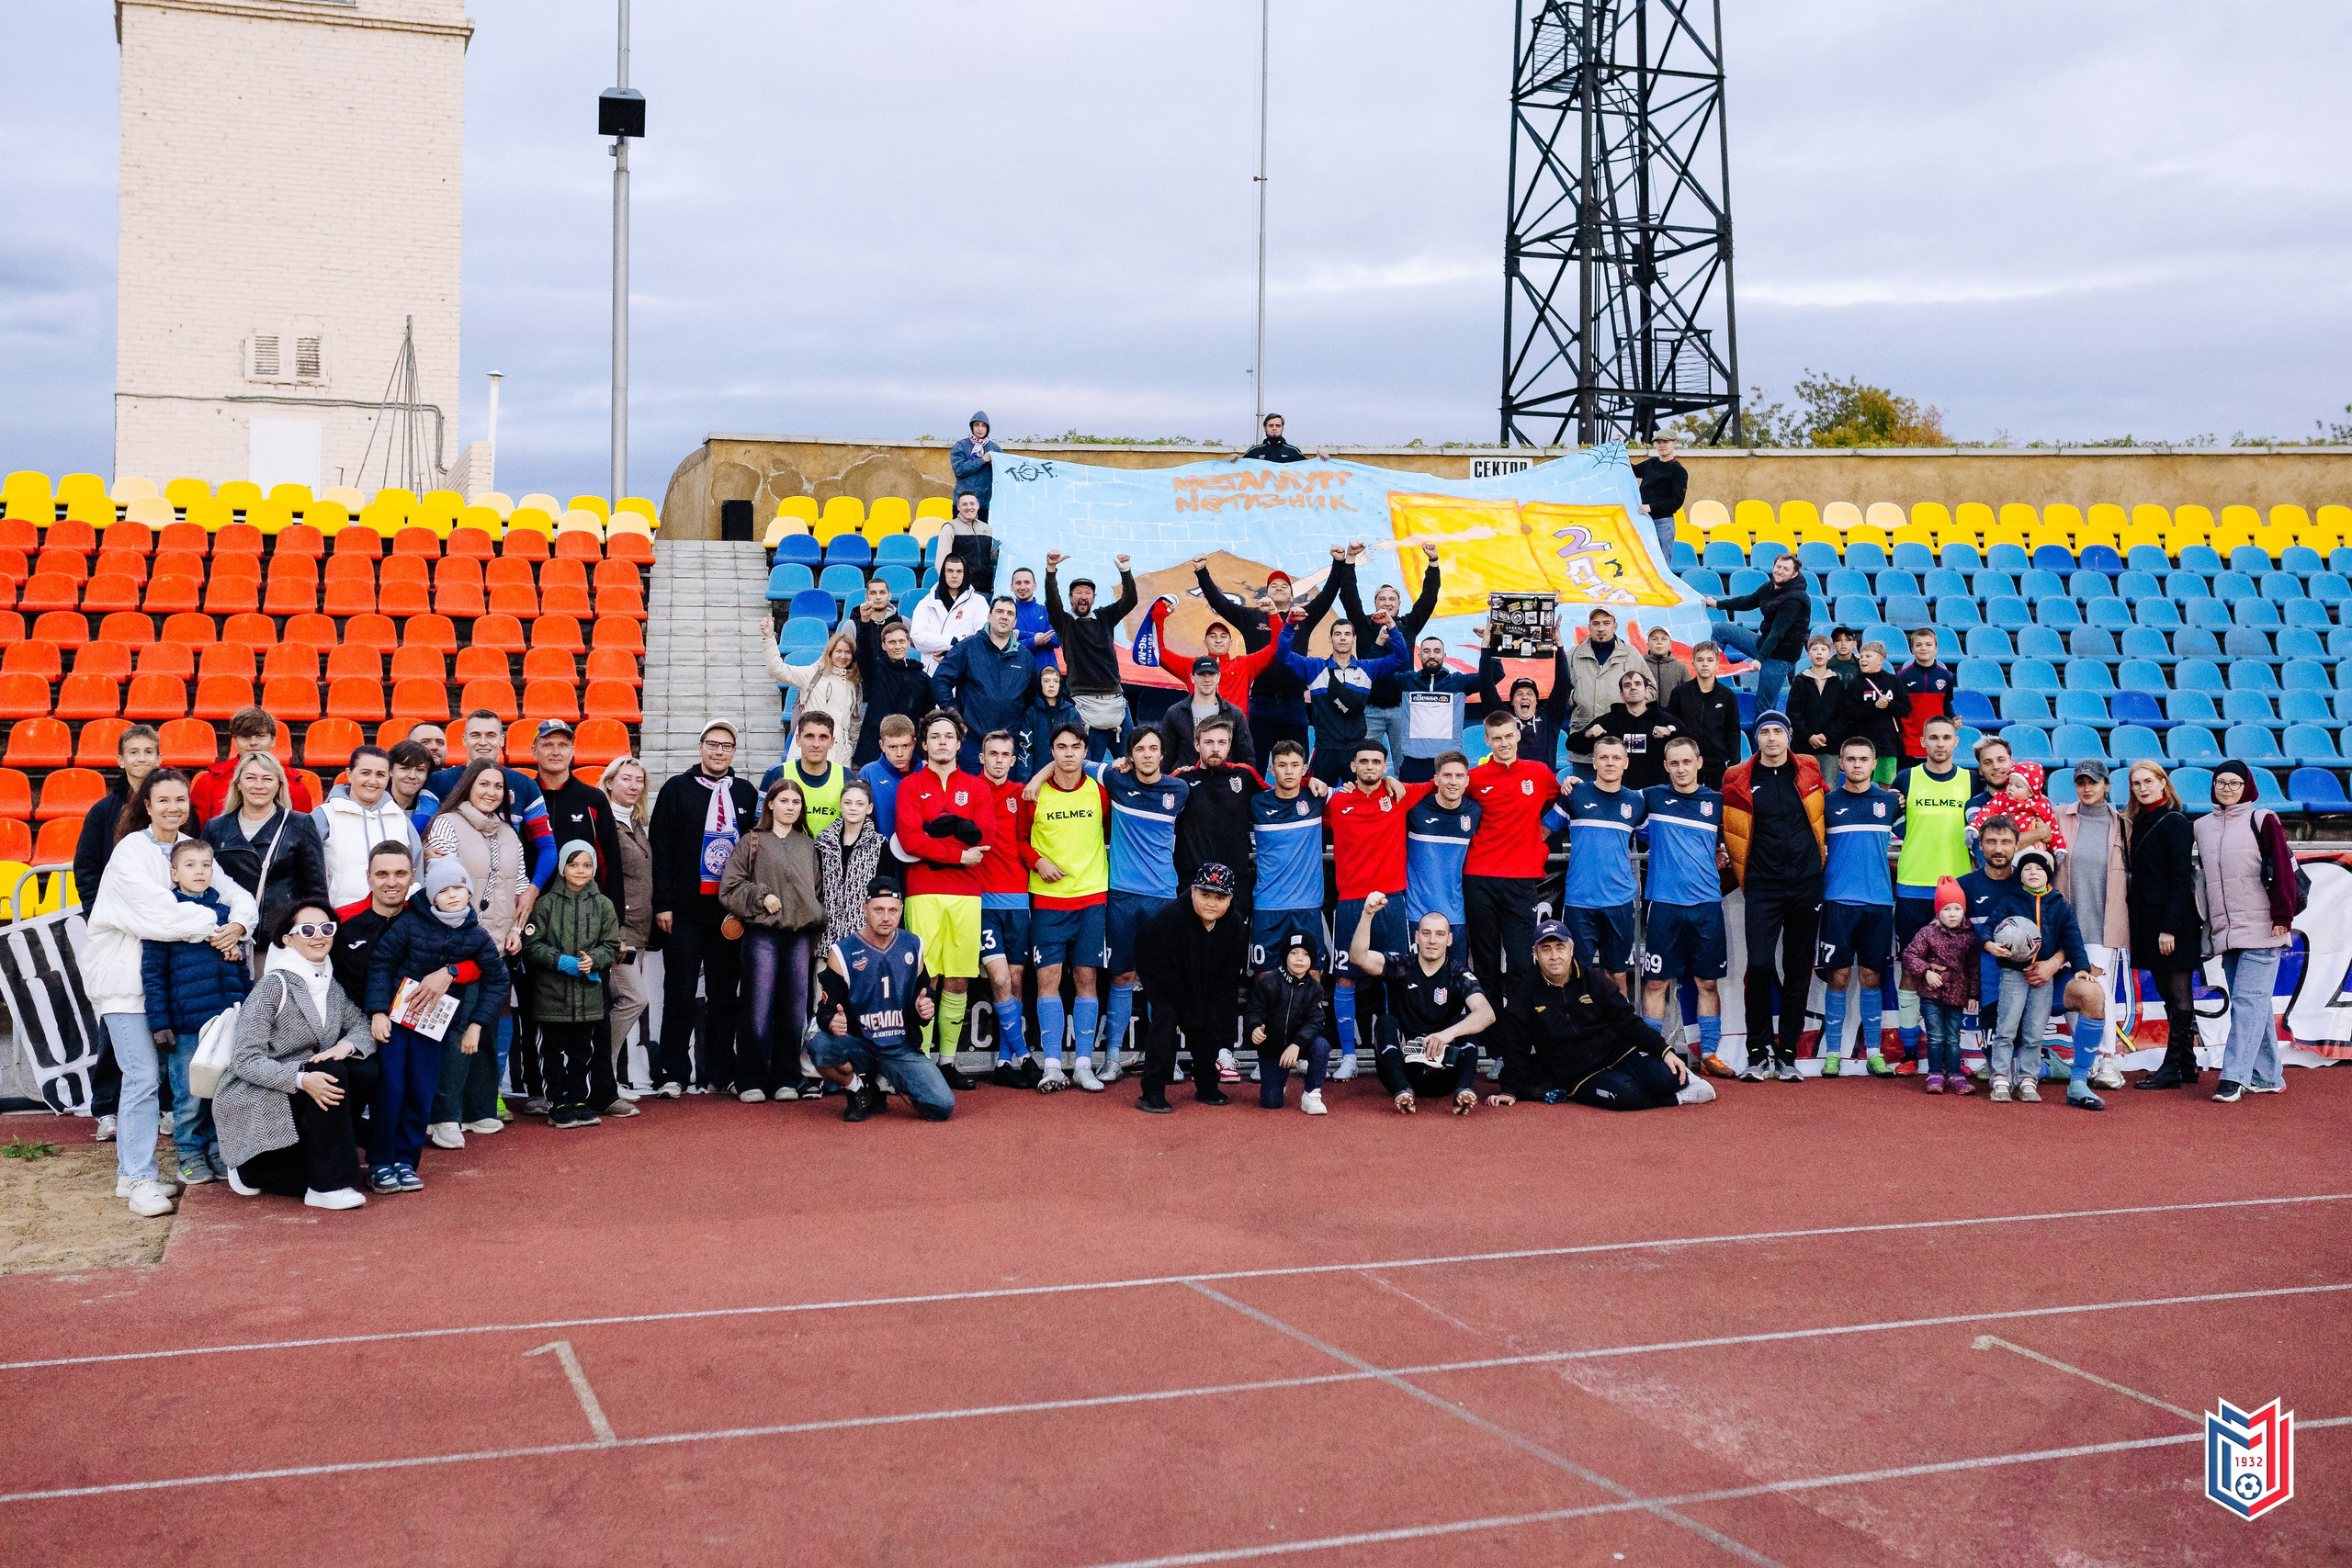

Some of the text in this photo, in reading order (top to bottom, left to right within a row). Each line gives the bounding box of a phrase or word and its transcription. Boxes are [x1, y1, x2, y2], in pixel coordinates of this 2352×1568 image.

[1412, 694, 1439, 703] ellesse
[1863, 689, 1894, 702] FIA
[1915, 797, 1957, 808] KELME
[1046, 809, 1086, 821] KELME
[1645, 952, 1663, 974] 69
[880, 976, 890, 998] 1
